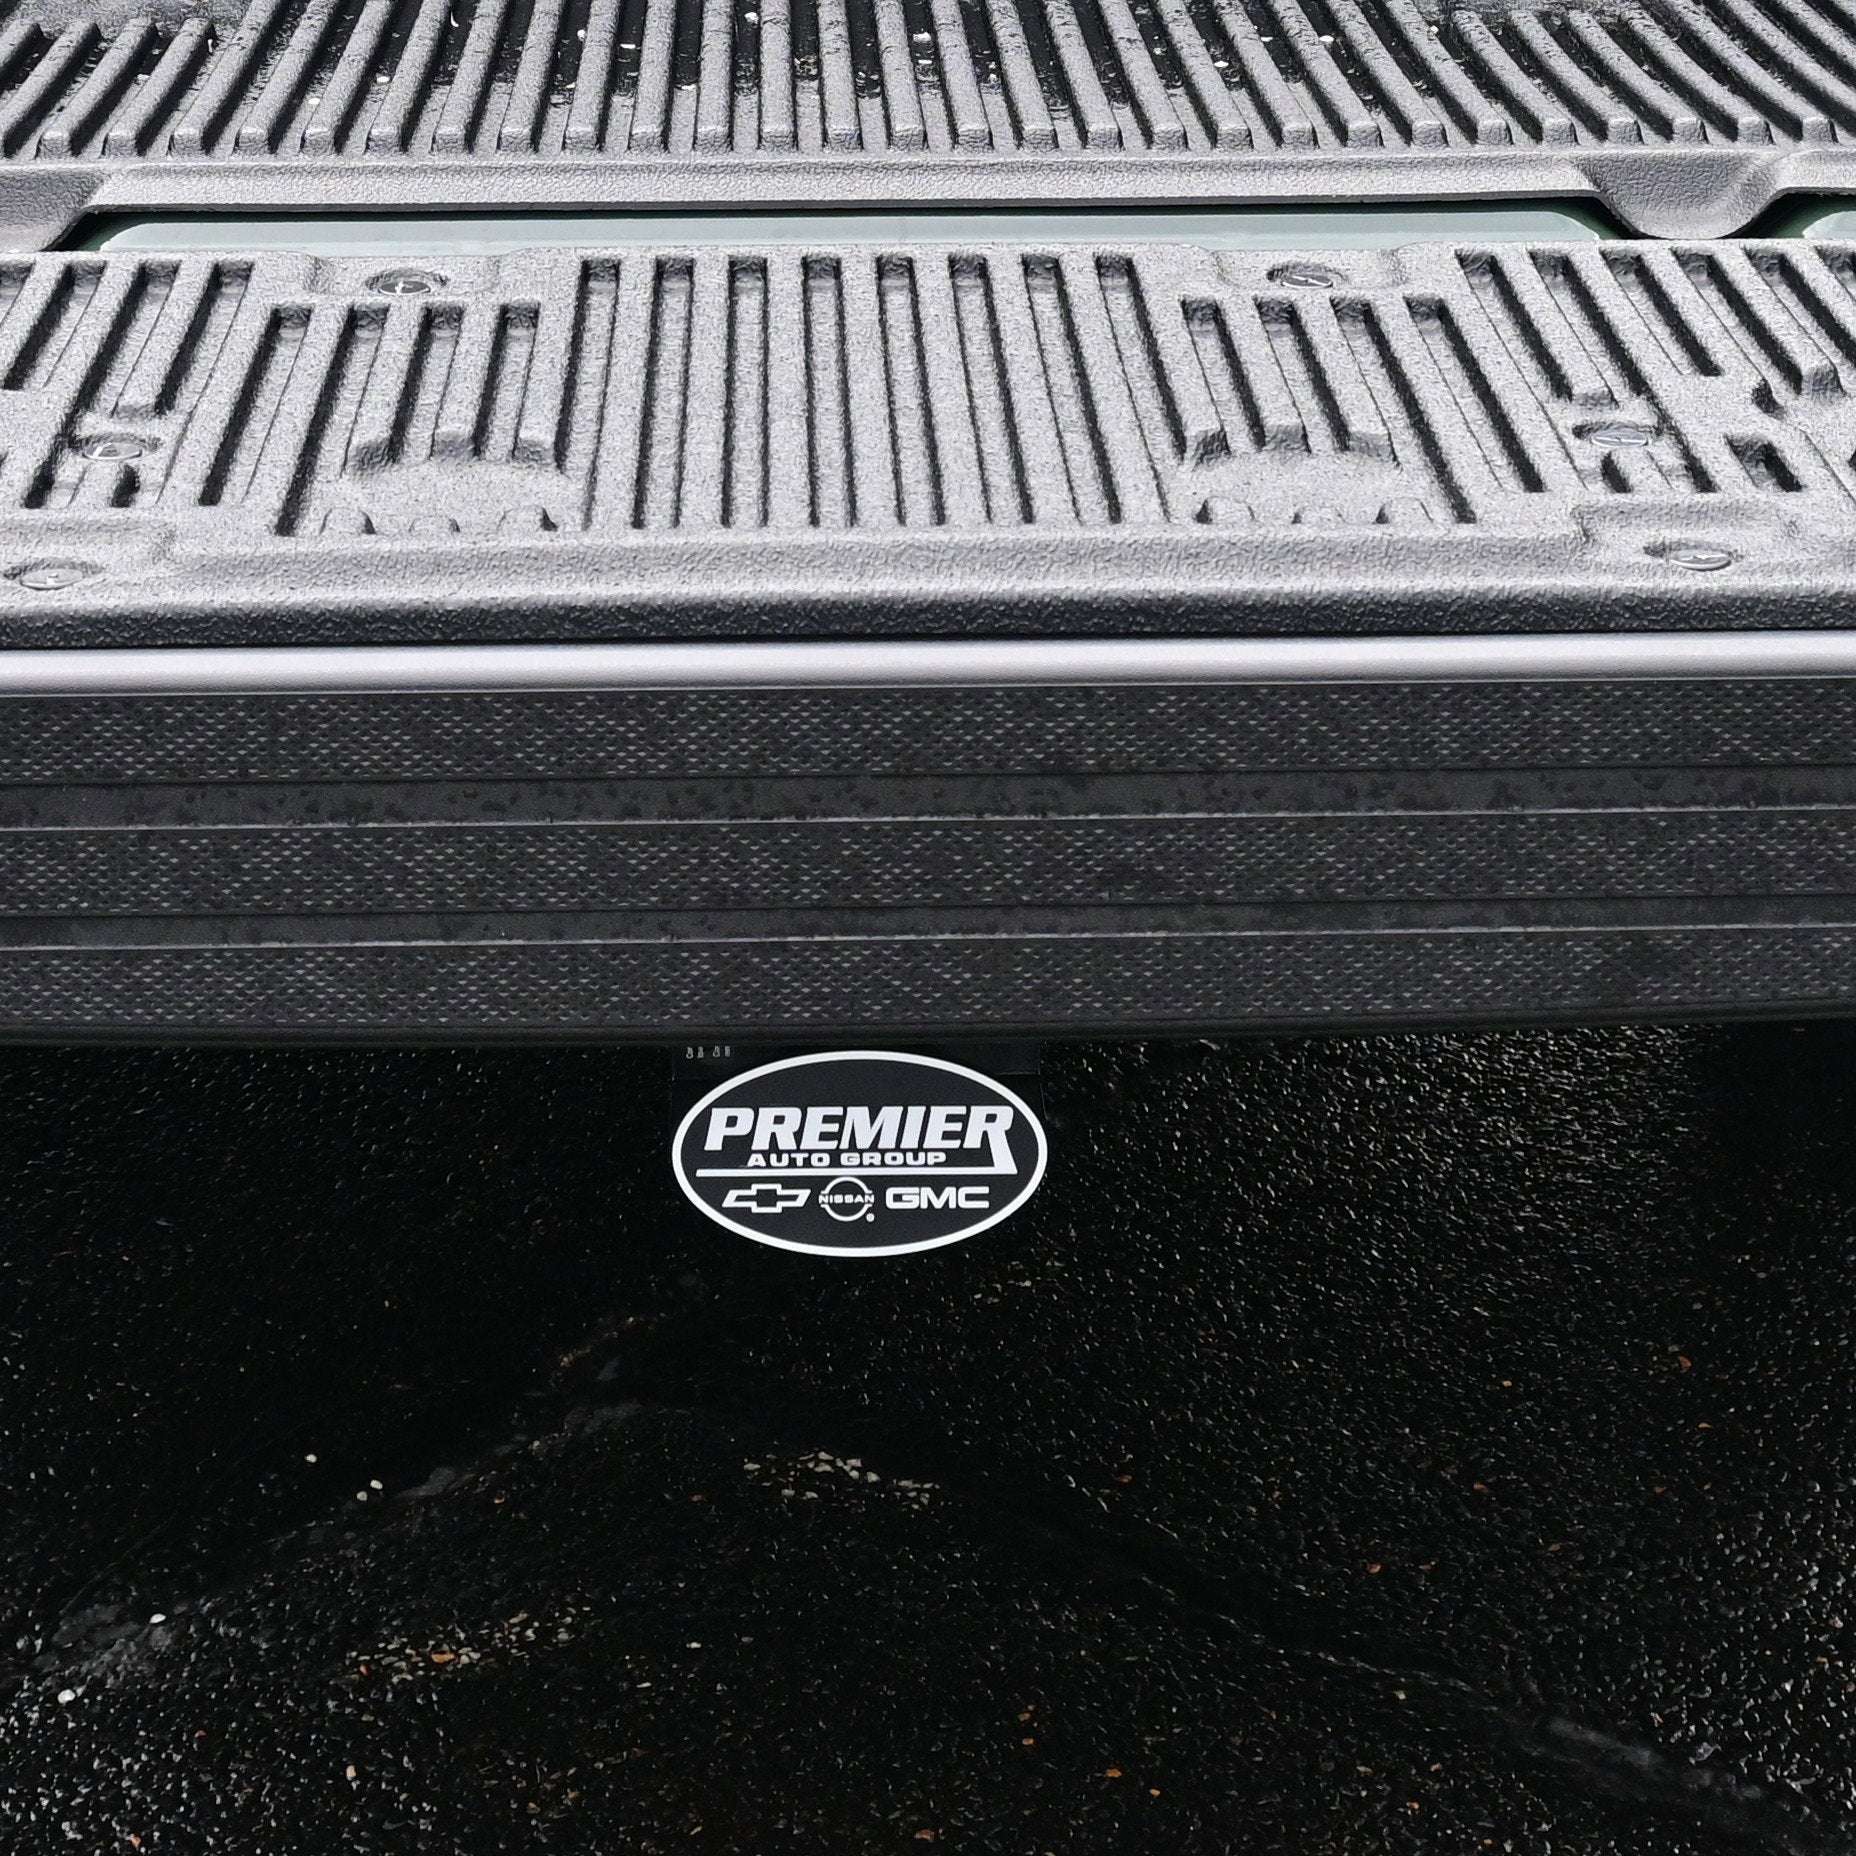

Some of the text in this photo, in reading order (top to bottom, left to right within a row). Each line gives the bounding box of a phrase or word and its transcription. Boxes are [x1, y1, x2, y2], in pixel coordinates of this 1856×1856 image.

[704, 1105, 1017, 1172] PREMIER
[746, 1151, 947, 1167] AUTO GROUP
[818, 1186, 990, 1210] NISSAN GMC
